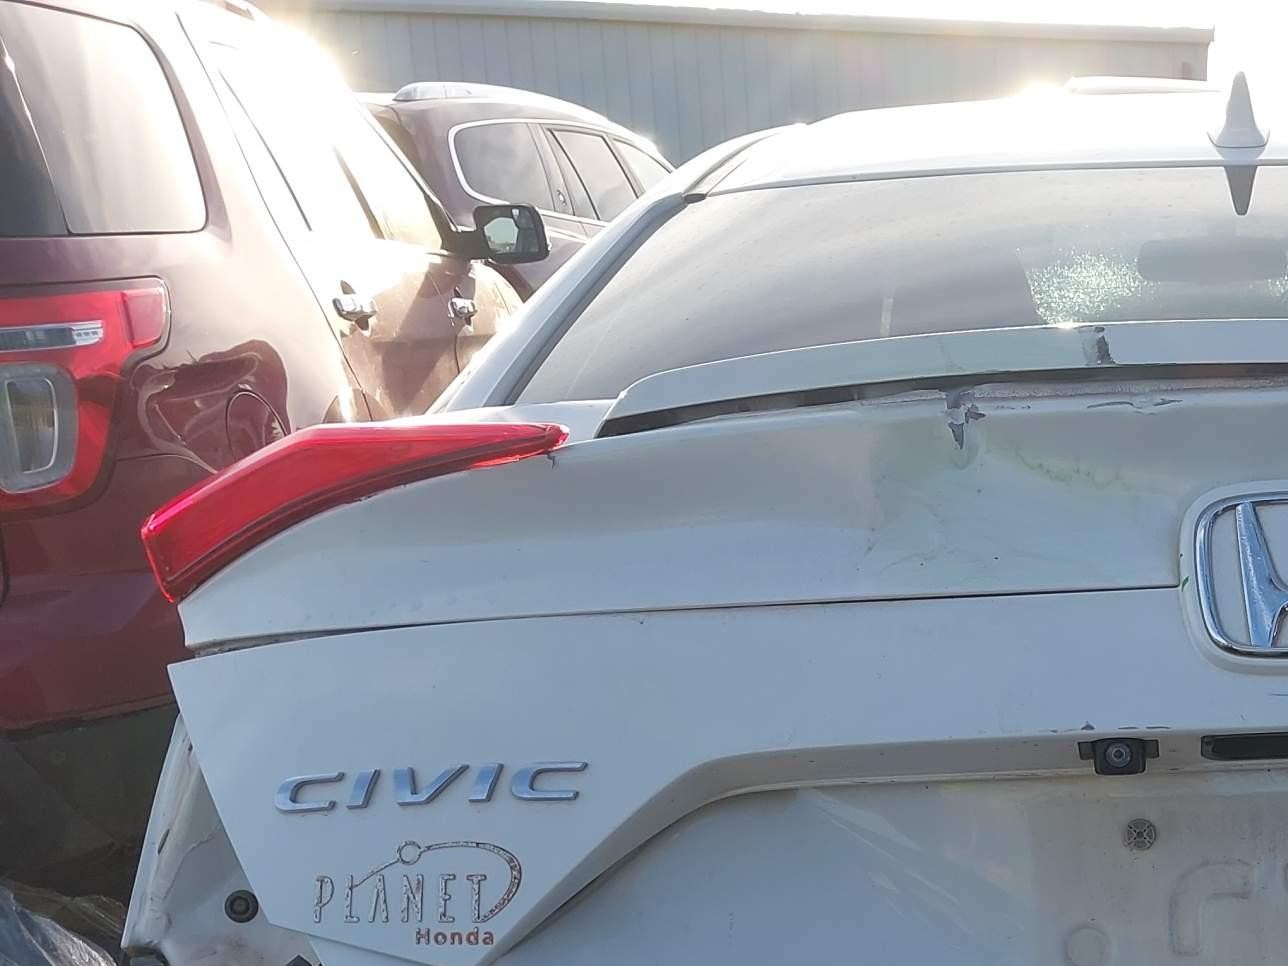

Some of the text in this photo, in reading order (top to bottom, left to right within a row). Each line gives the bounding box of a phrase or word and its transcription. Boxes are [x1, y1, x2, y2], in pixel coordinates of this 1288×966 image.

[274, 761, 588, 814] CIVIC
[312, 872, 488, 924] PLANET
[415, 927, 495, 946] Honda
